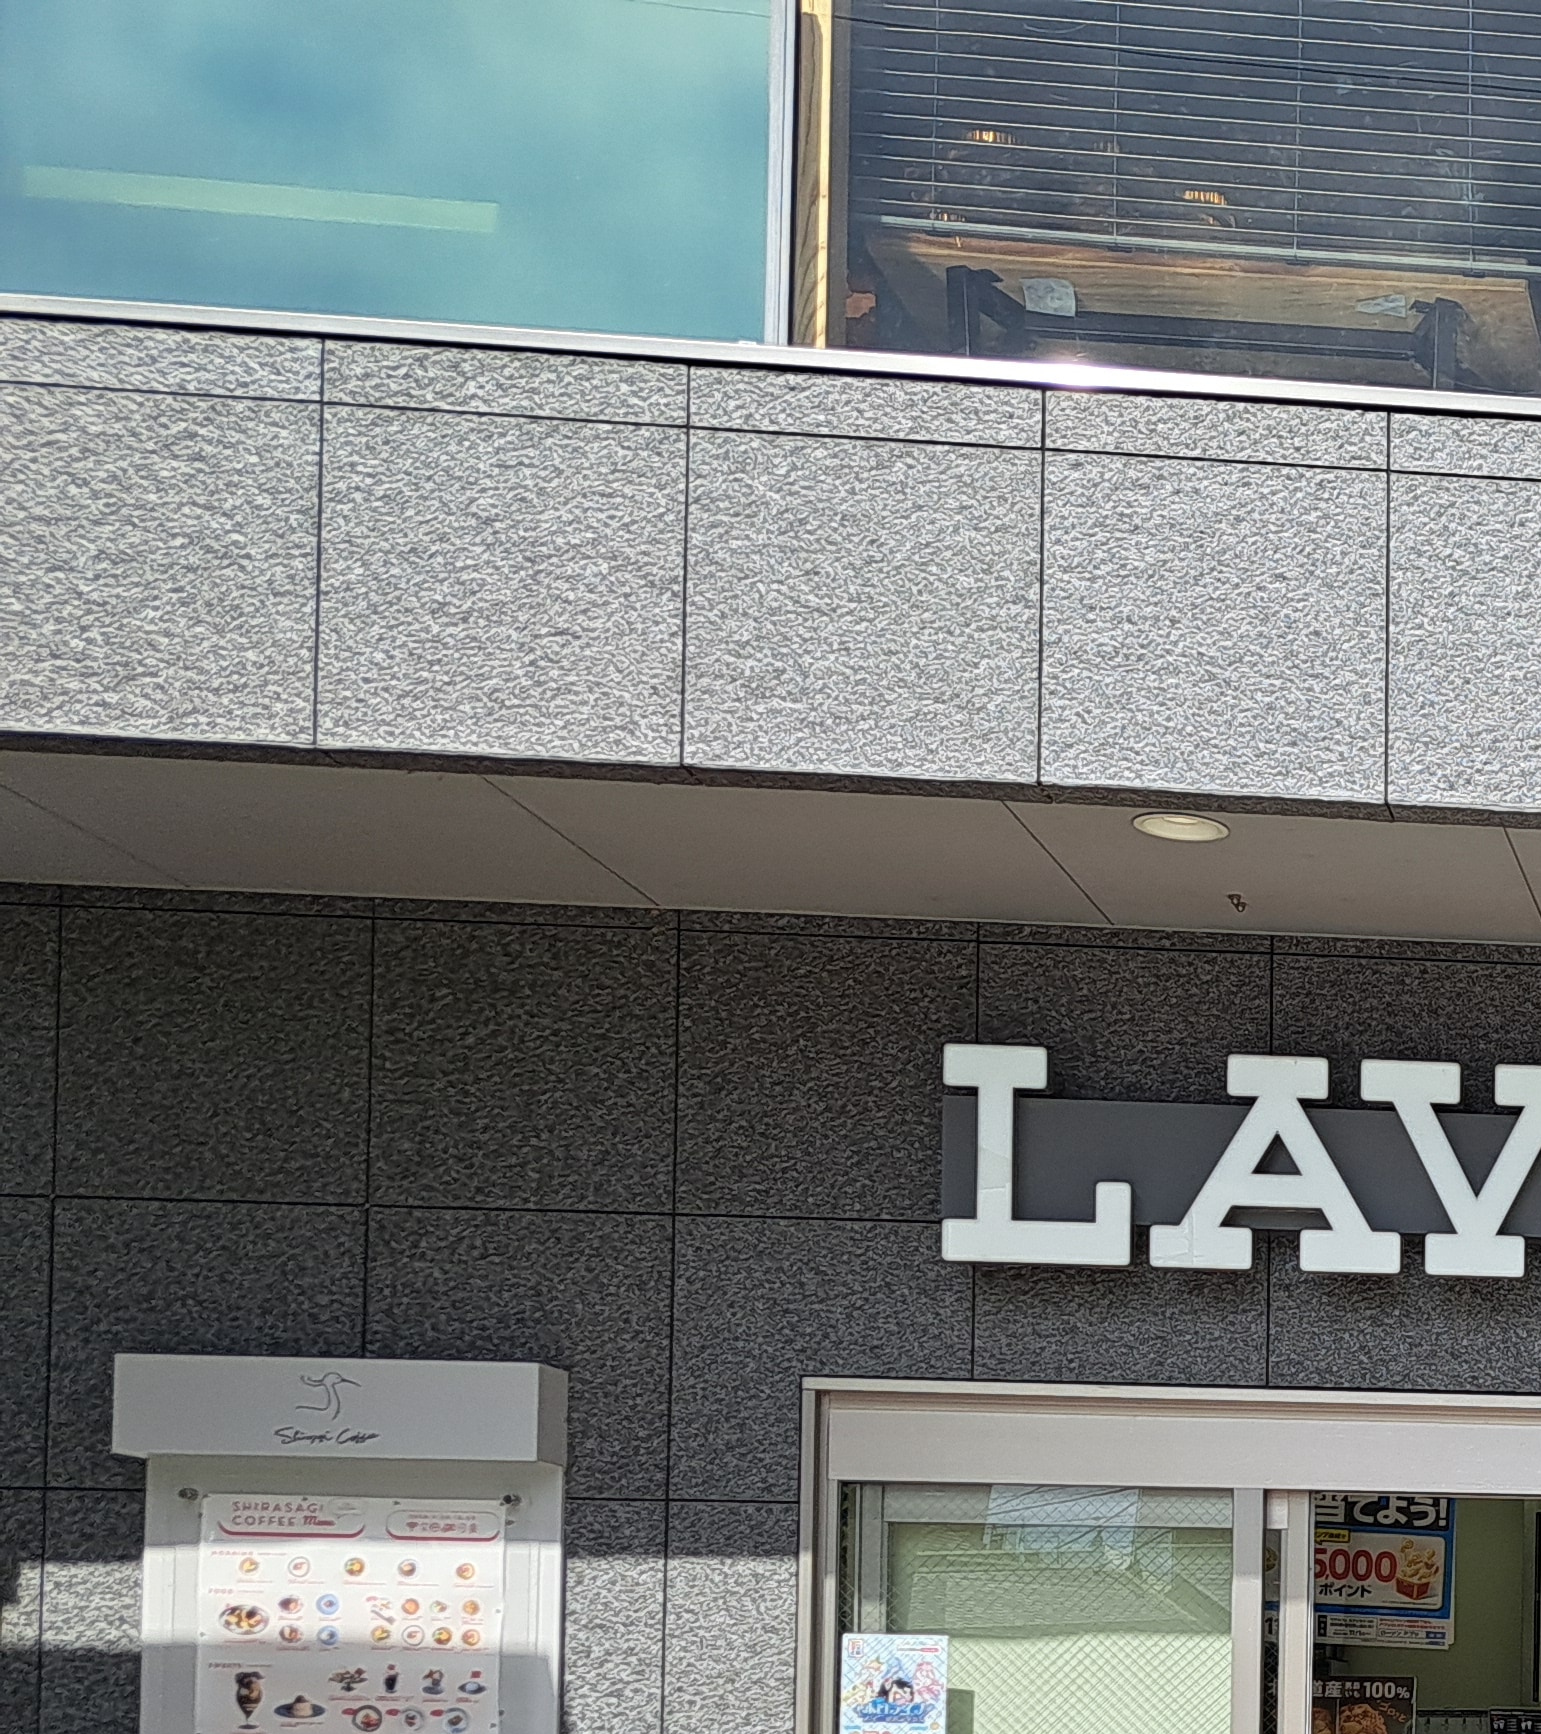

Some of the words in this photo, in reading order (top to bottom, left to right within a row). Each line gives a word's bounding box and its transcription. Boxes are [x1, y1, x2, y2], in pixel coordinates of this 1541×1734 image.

[232, 1501, 324, 1514] SHIRASAGI
[232, 1515, 295, 1527] COFFEE
[1319, 1583, 1372, 1598] ポイント
[1363, 1681, 1411, 1699] 100%
